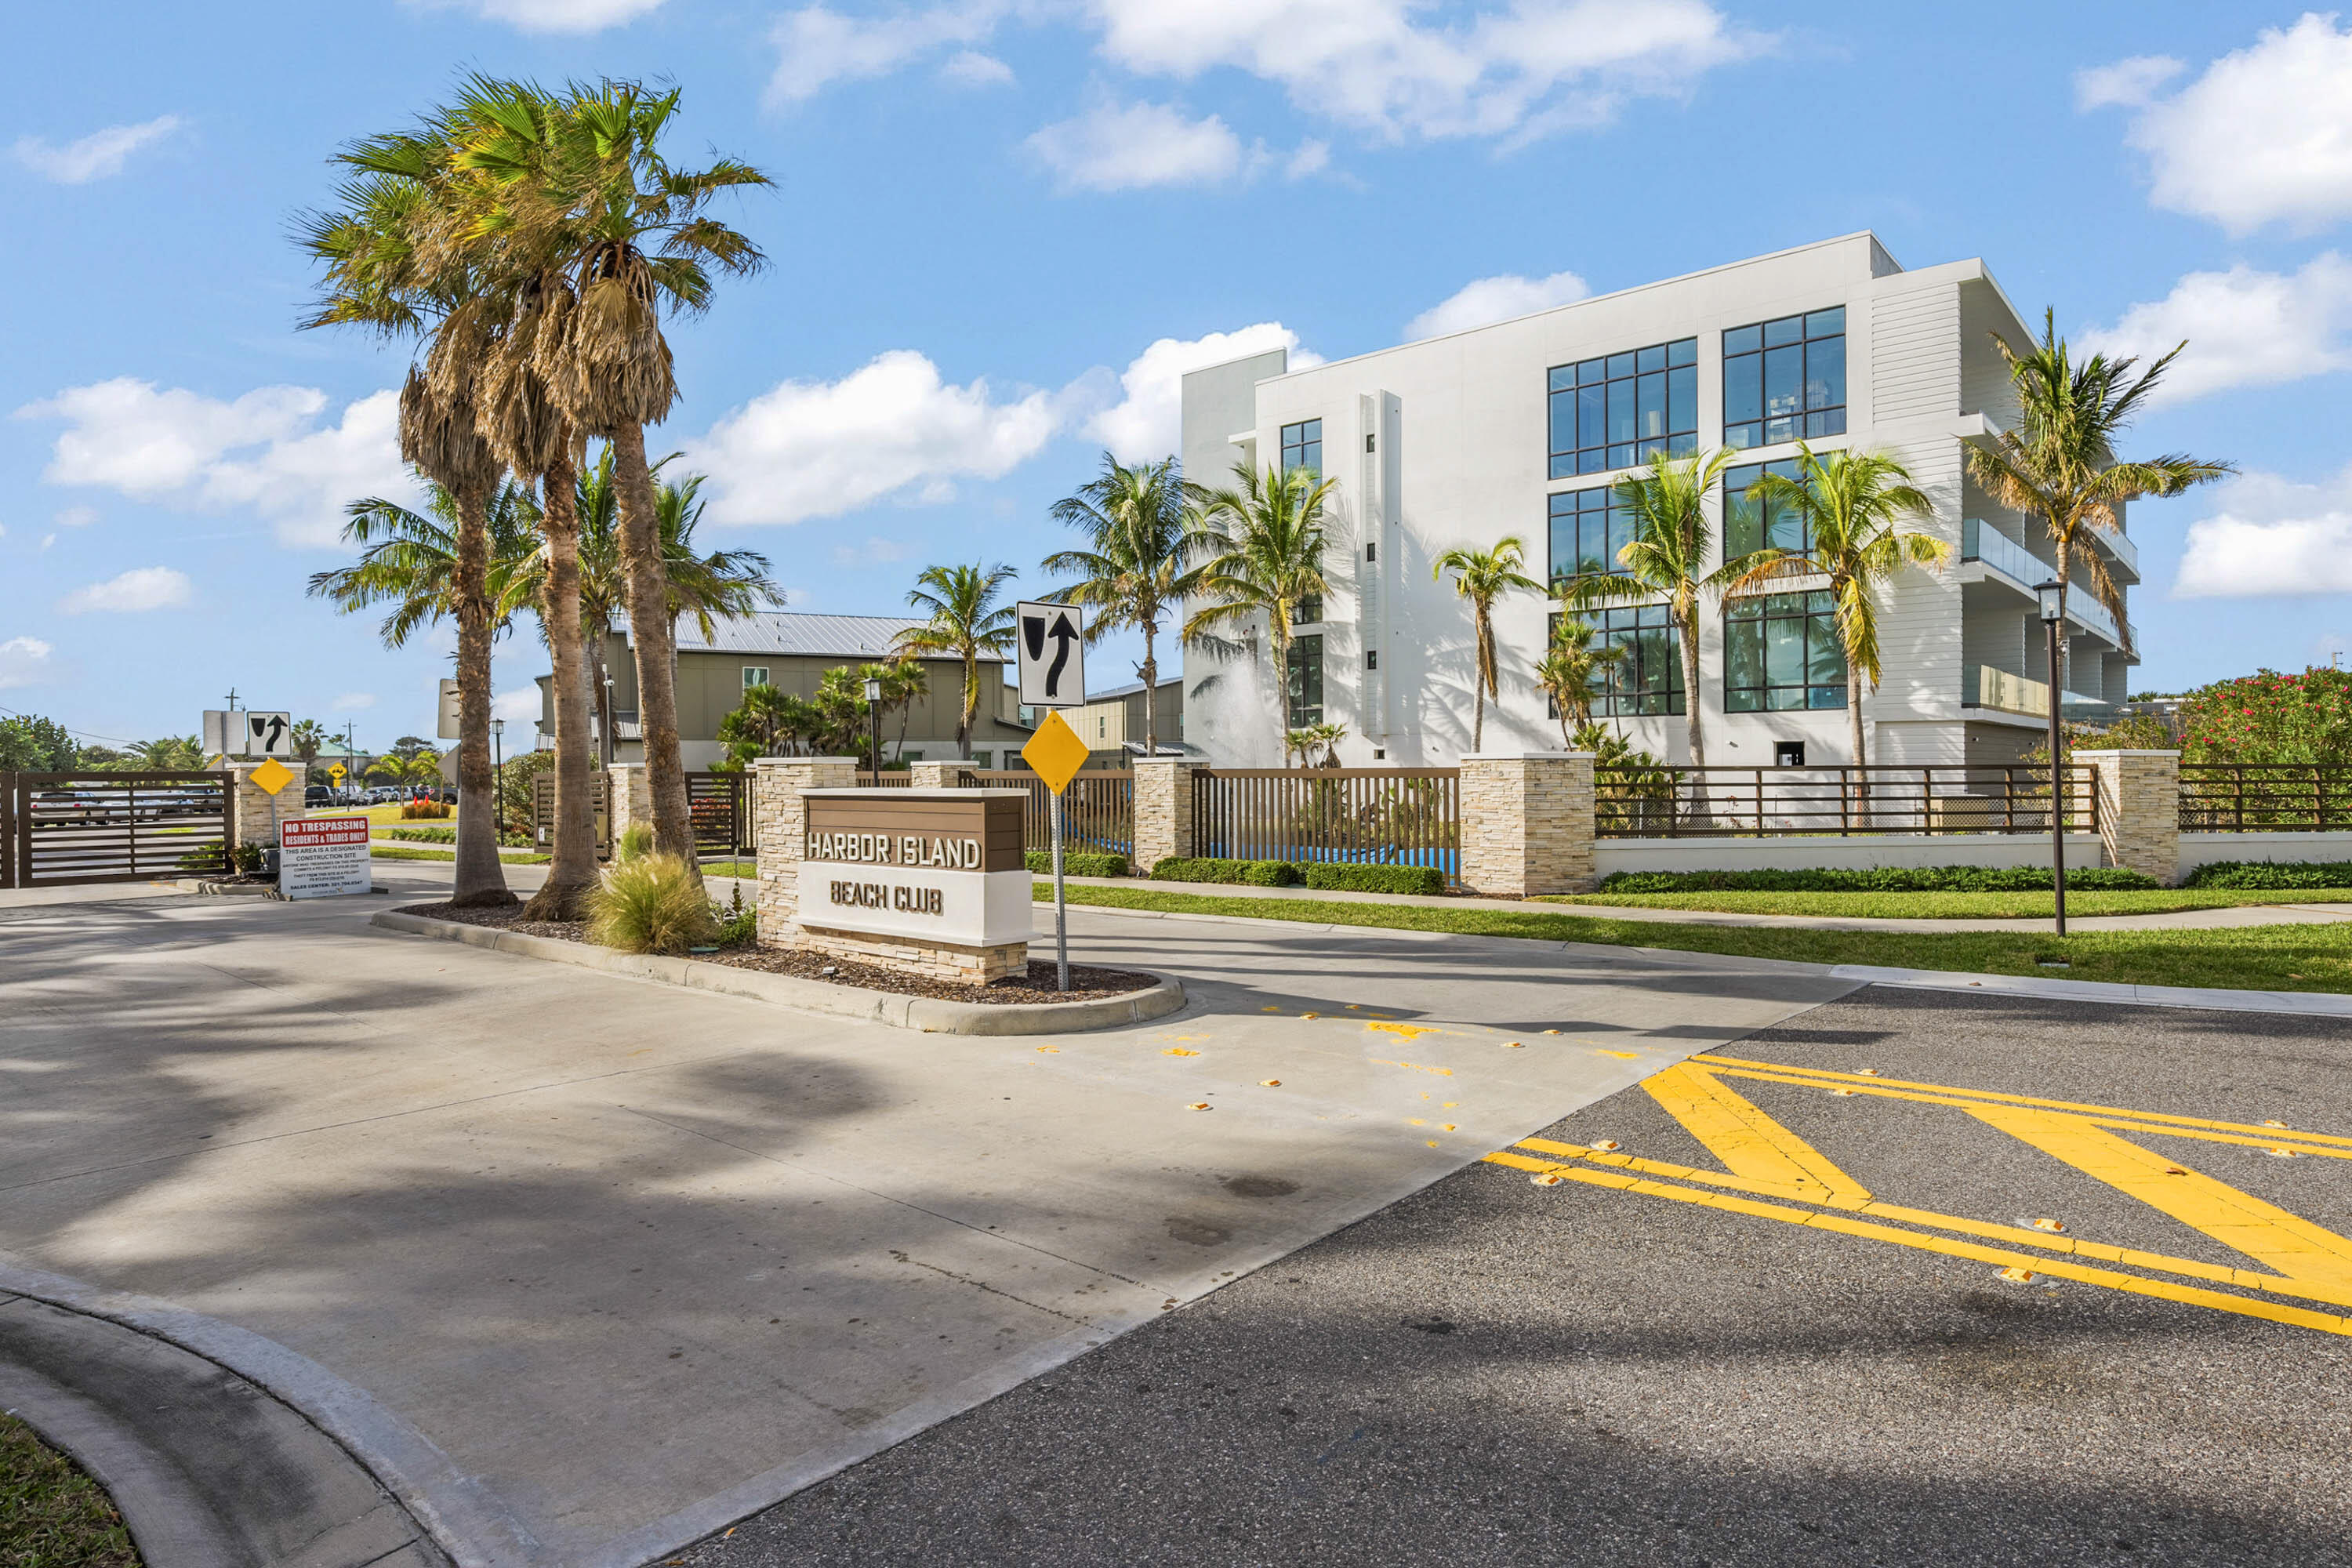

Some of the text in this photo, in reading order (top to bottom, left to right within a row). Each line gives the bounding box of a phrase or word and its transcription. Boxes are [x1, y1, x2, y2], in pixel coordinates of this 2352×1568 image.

[285, 820, 365, 833] NO TRESPASSING
[285, 834, 319, 845] RESIDENTS
[326, 833, 348, 843] TRADES
[350, 832, 366, 841] ONLY!
[808, 832, 981, 869] HARBOR ISLAND
[830, 880, 942, 916] BEACH CLUB
